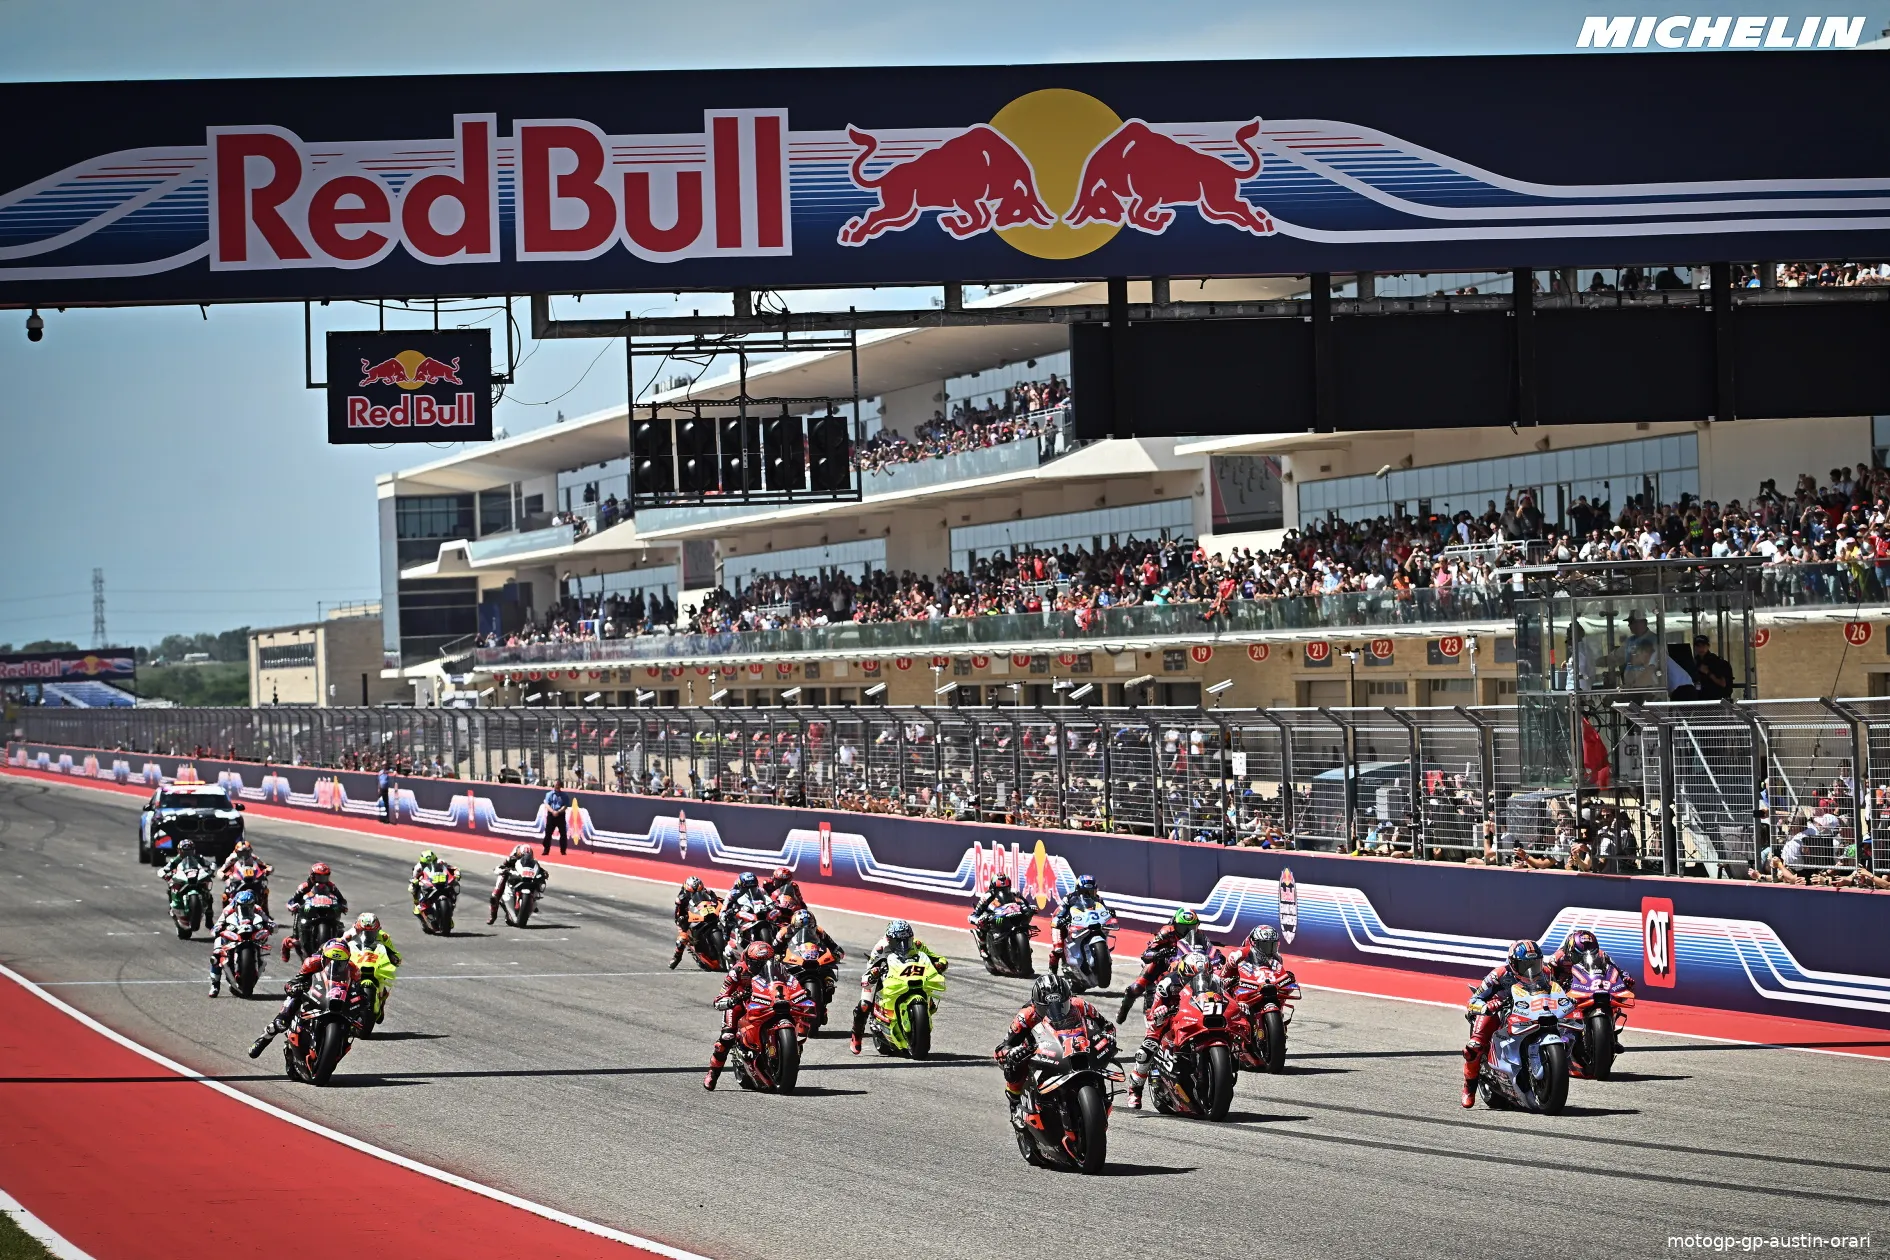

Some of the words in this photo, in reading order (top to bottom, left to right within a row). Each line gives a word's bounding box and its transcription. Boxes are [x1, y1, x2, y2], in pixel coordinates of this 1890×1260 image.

[208, 113, 500, 270] Red
[515, 109, 791, 261] Bull
[347, 394, 411, 428] Red
[413, 392, 476, 427] Bull
[1851, 624, 1866, 641] 26
[1253, 645, 1265, 657] 20
[1312, 643, 1323, 656] 21
[1376, 641, 1389, 654] 22
[1445, 638, 1458, 652] 23
[1063, 653, 1073, 663] 18
[1196, 646, 1207, 659] 19
[899, 657, 908, 667] 14
[976, 656, 985, 666] 16
[1645, 908, 1670, 974] QT
[357, 952, 379, 964] 72
[899, 965, 926, 978] 49
[1256, 969, 1276, 984] 23
[1239, 980, 1258, 991] Lenovo
[751, 995, 771, 1006] Lenovo
[1530, 997, 1559, 1013] 93
[1203, 1002, 1223, 1015] 31
[1062, 1035, 1090, 1058] 12
